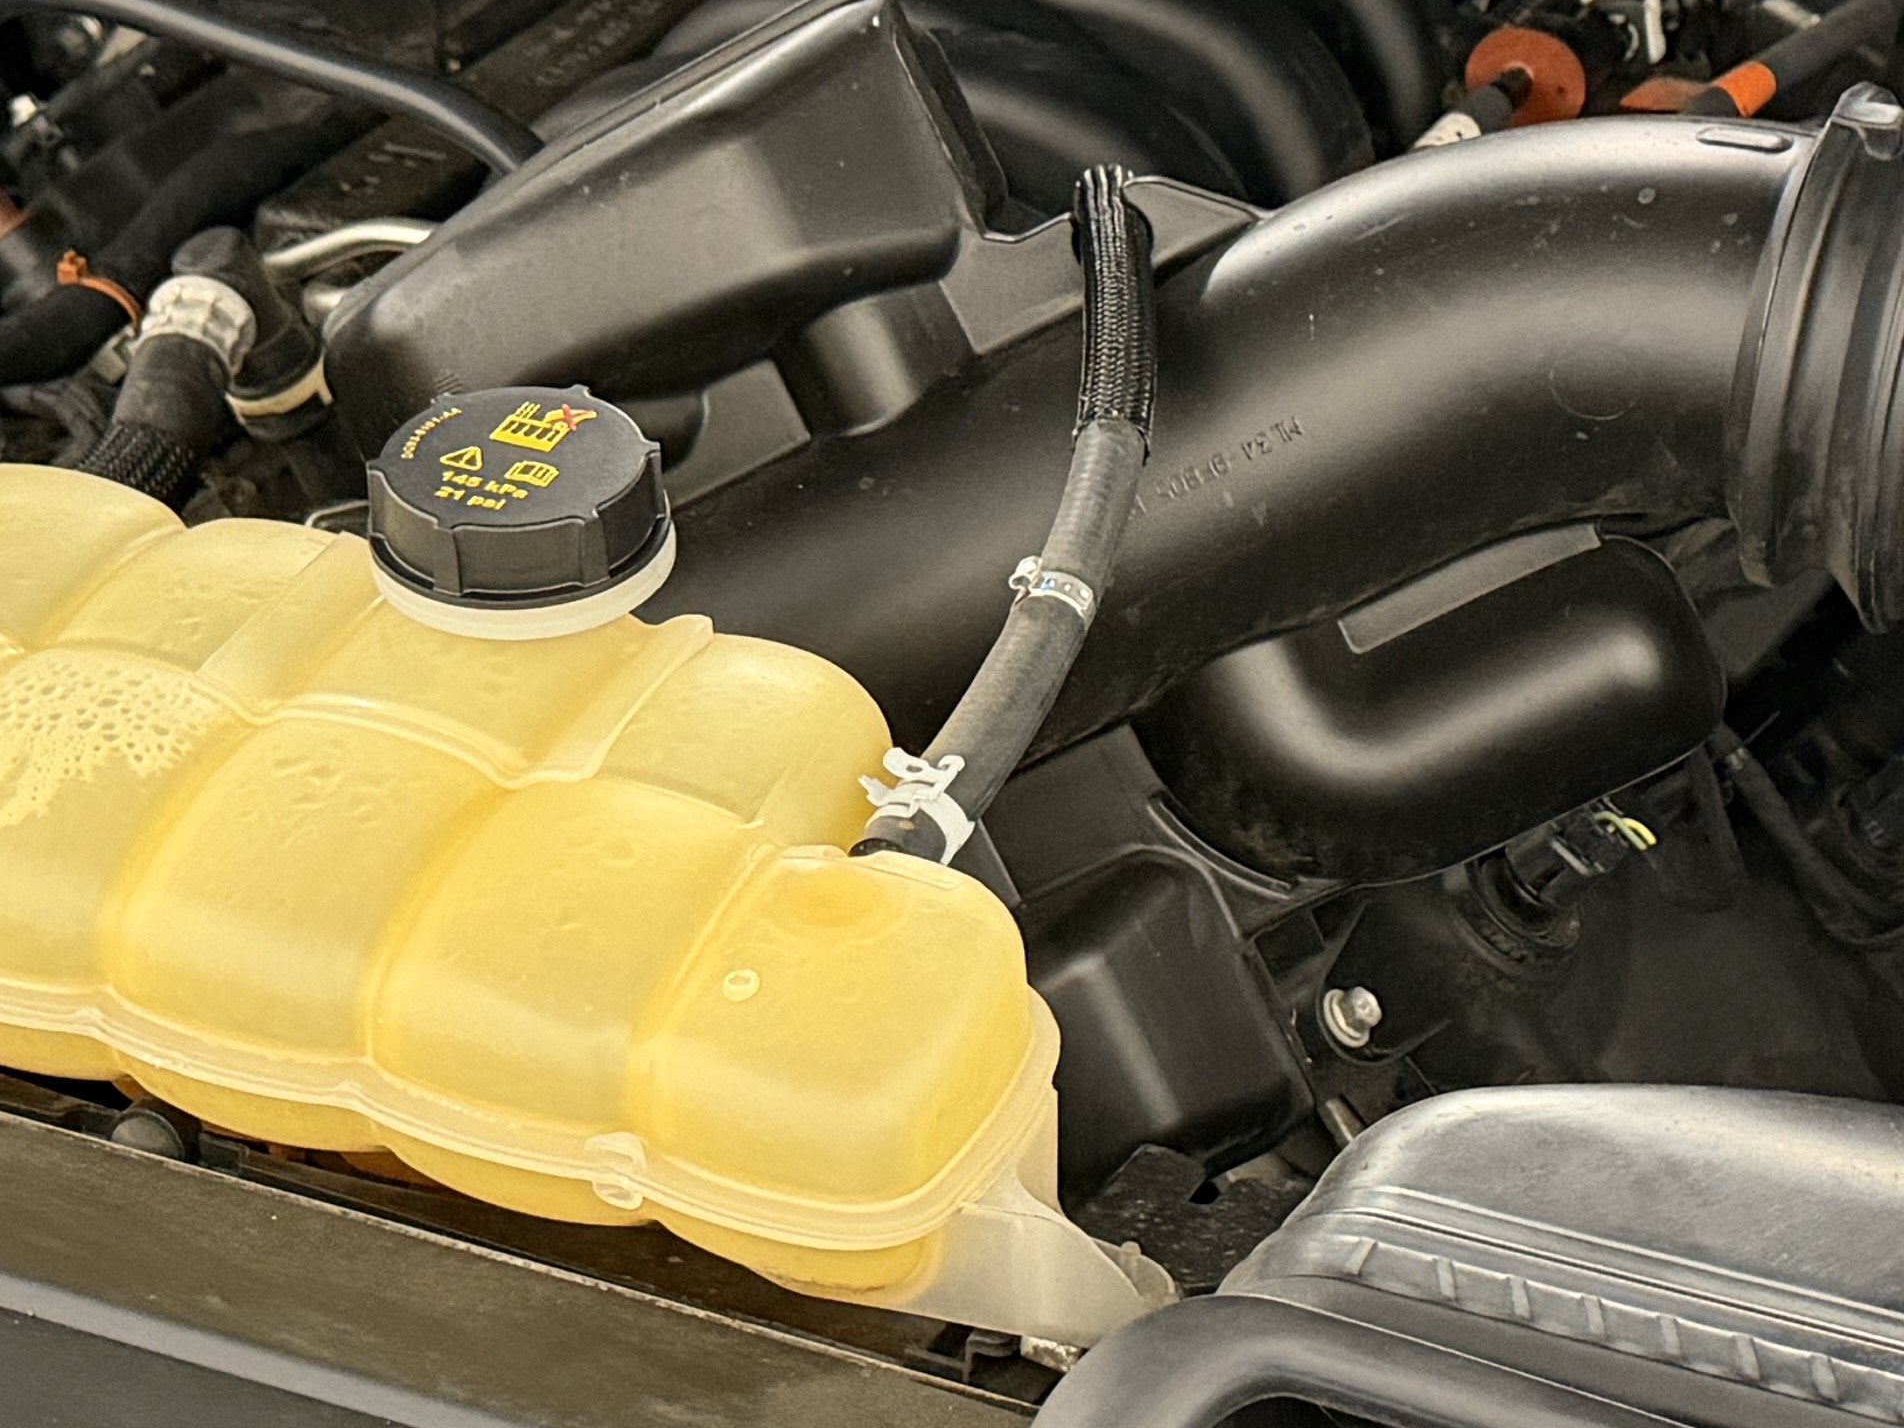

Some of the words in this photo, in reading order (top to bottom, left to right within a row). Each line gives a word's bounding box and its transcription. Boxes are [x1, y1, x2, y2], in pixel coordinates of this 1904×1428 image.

[442, 471, 483, 487] 145
[485, 481, 528, 498] kPa
[435, 487, 466, 500] 21
[467, 496, 506, 510] psi
